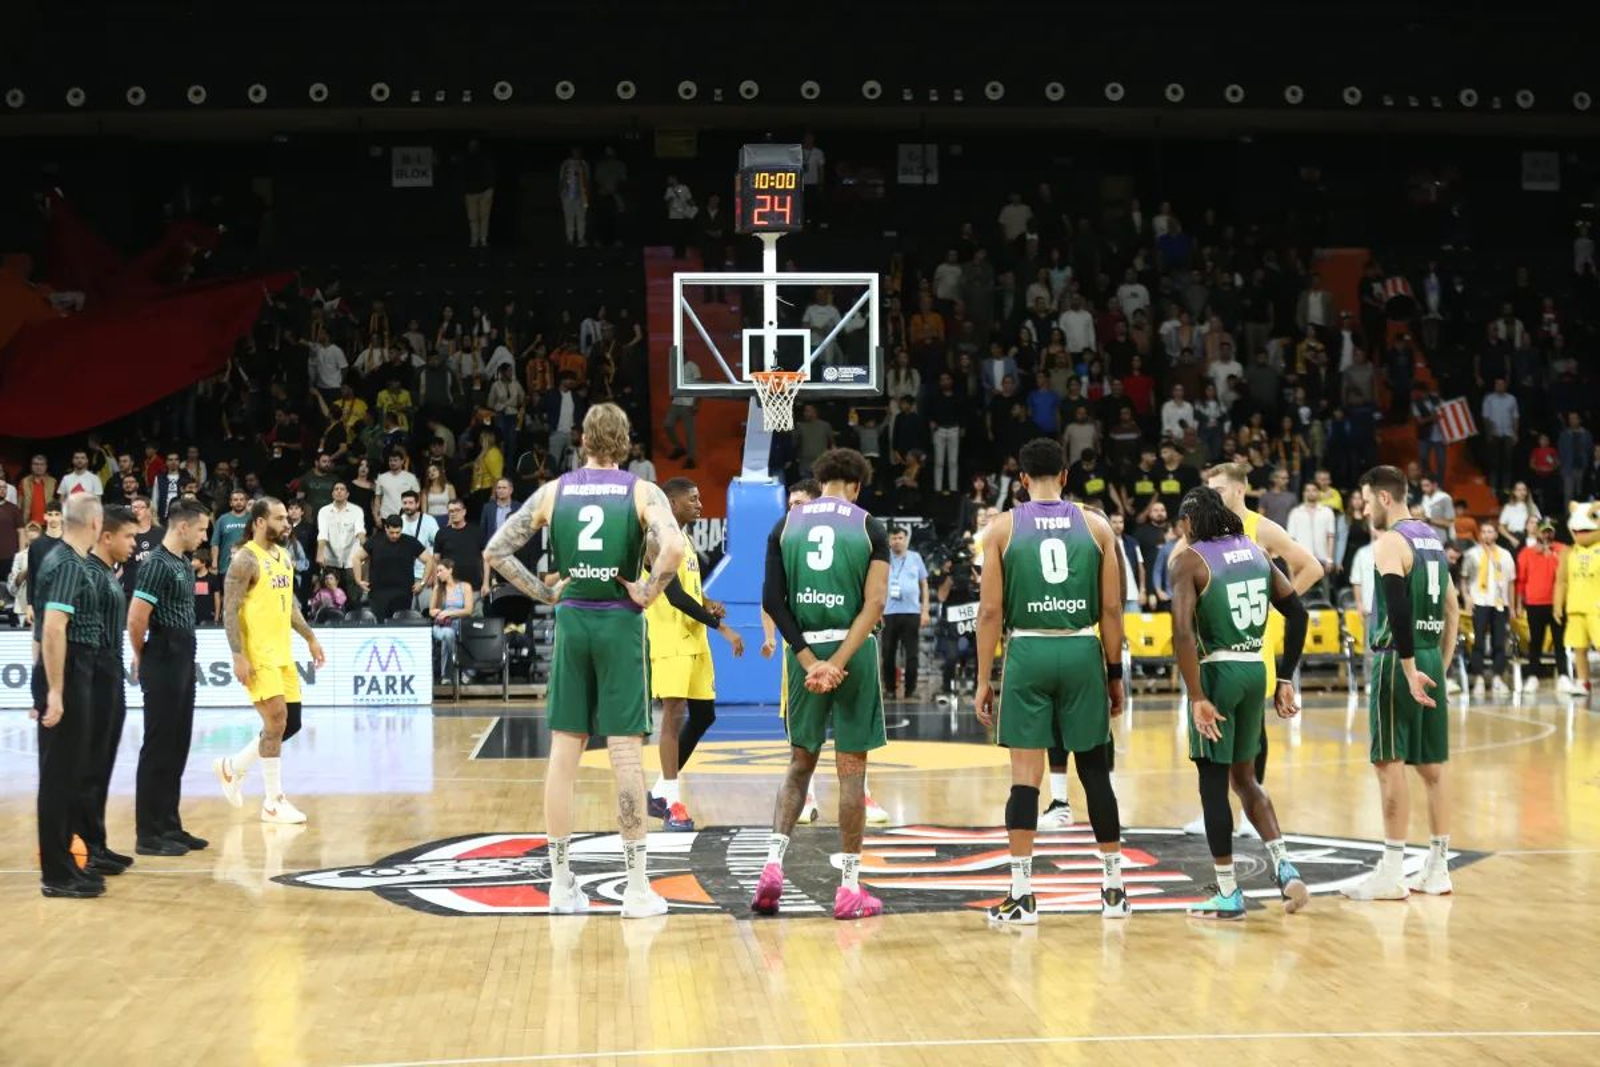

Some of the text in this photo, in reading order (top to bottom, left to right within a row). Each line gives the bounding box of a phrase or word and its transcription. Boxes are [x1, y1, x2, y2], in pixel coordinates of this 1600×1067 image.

[754, 172, 796, 189] 10:00
[753, 195, 792, 225] 24
[577, 504, 604, 551] 2
[1034, 516, 1071, 530] TYSON
[806, 525, 835, 571] 3
[1039, 538, 1069, 585] 0
[1222, 548, 1254, 565] PERRY
[1225, 577, 1267, 631] 55
[353, 675, 415, 695] PARK
